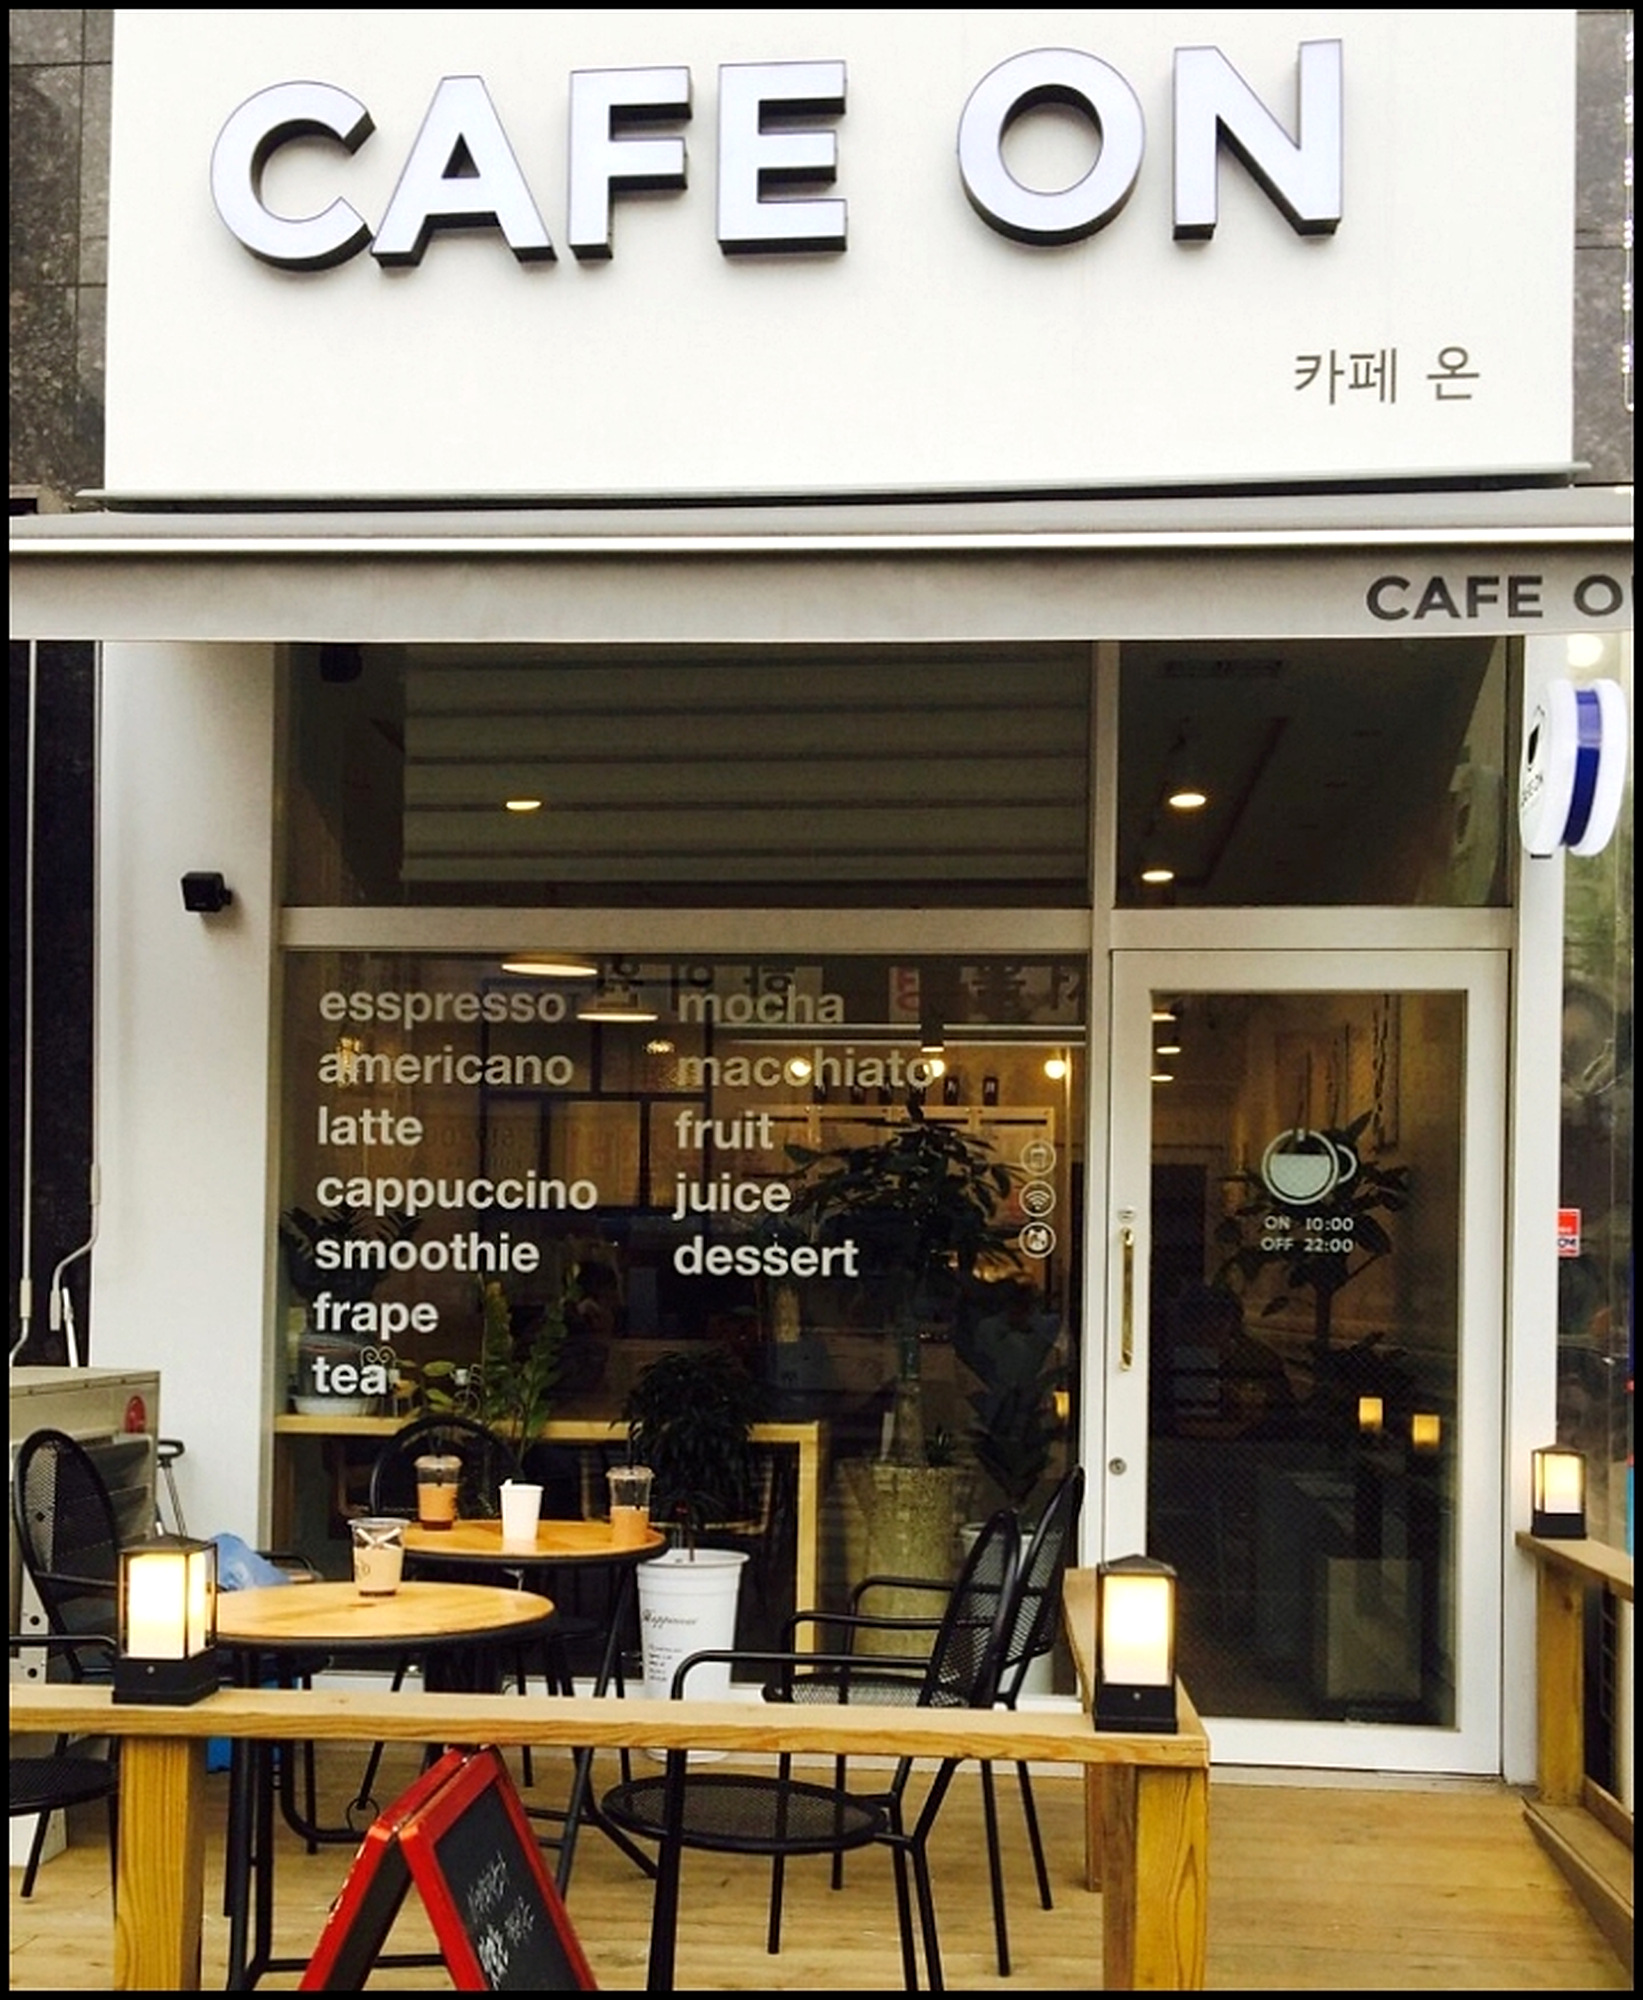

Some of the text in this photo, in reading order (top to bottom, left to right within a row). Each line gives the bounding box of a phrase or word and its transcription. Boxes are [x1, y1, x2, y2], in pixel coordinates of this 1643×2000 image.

[209, 38, 1344, 271] CAFE ON
[1294, 345, 1481, 405] 카페 온
[1366, 574, 1634, 621] CAFE O
[318, 989, 568, 1030] esspresso
[678, 985, 845, 1024] mocha
[317, 1045, 574, 1086] americano
[676, 1047, 936, 1088] macchiato
[317, 1106, 424, 1147] latte
[675, 1110, 774, 1150] fruit
[316, 1170, 598, 1217] cappuccino
[672, 1172, 792, 1221] juice
[1264, 1216, 1354, 1231] ON 10:00
[314, 1232, 540, 1273] smoothie
[673, 1237, 860, 1278] dessert
[1261, 1237, 1354, 1252] OFF 22:00
[313, 1291, 439, 1340] frape
[312, 1357, 388, 1395] tea
